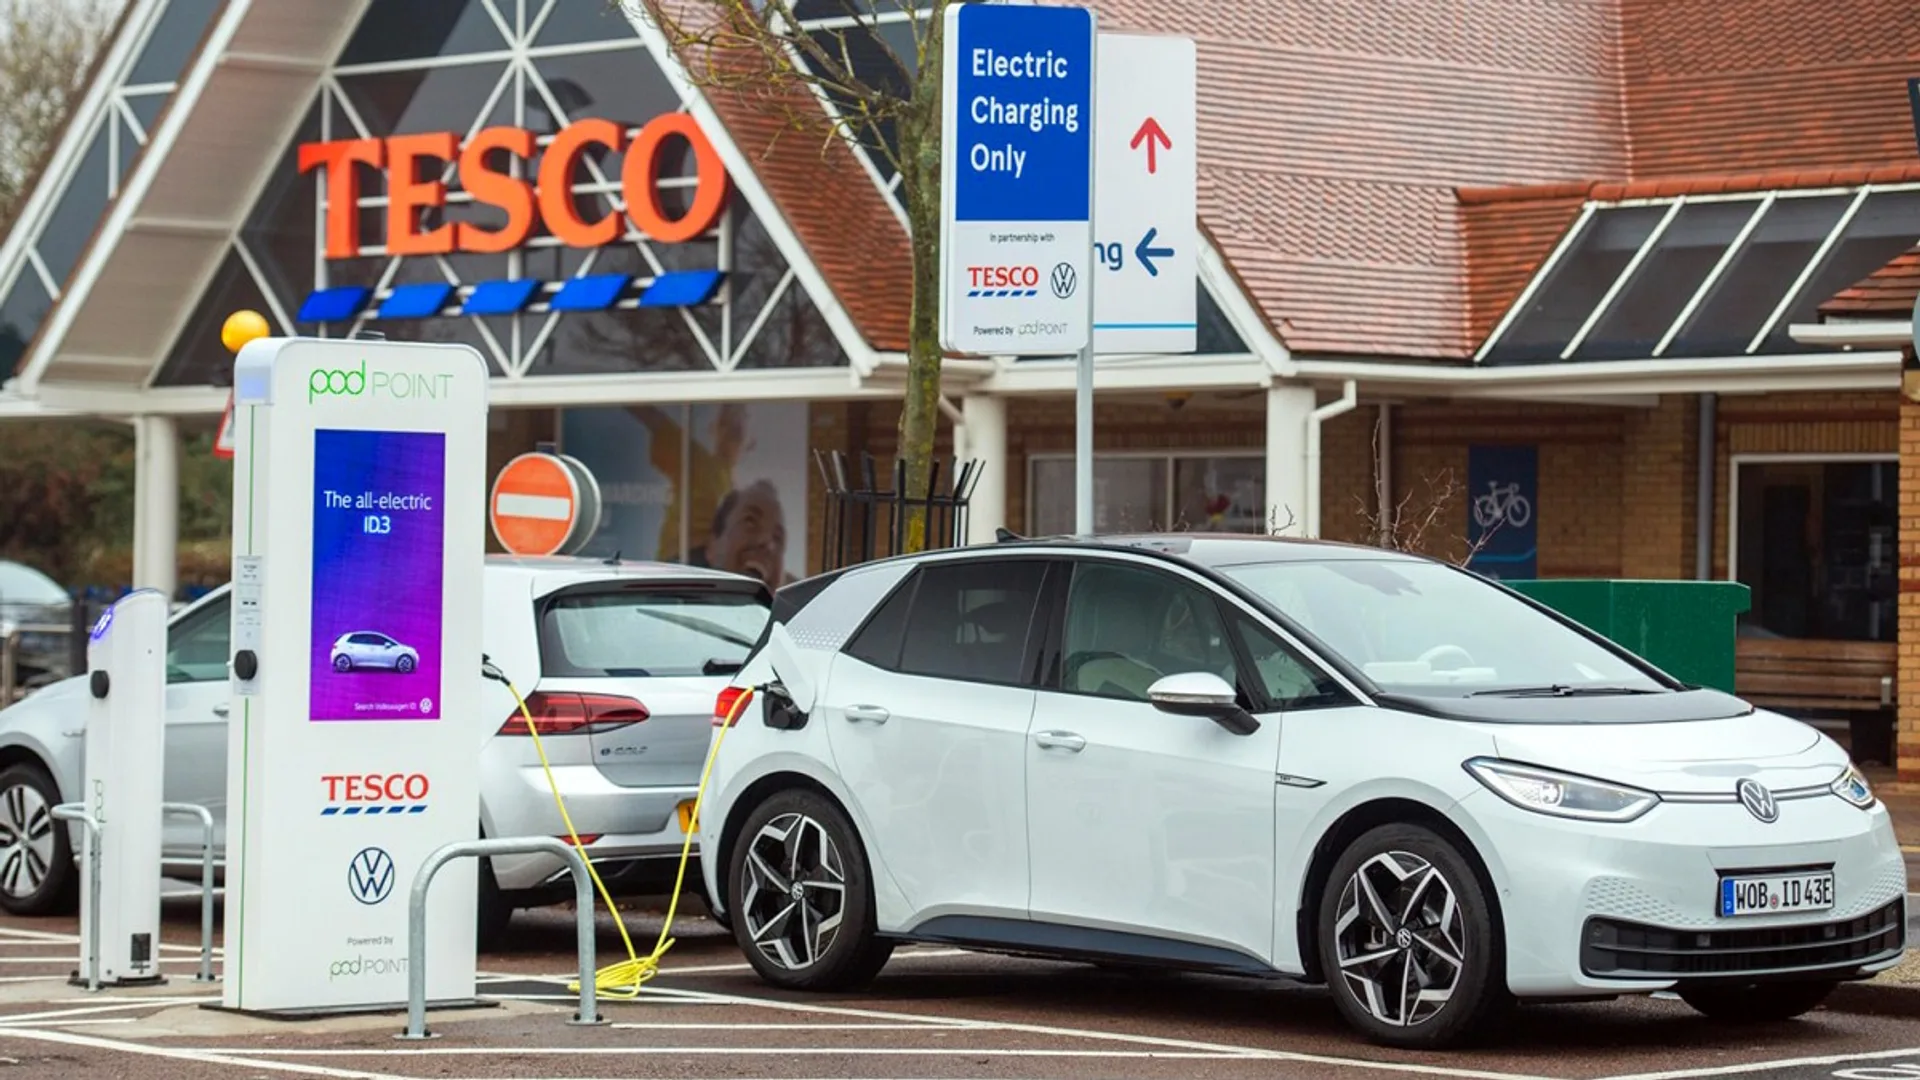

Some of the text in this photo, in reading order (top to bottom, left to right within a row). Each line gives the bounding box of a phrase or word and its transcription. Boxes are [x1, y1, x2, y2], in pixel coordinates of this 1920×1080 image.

[972, 48, 1068, 78] Electric
[970, 96, 1079, 133] Charging
[970, 143, 1027, 179] Only
[299, 112, 728, 259] TESCO
[990, 233, 1055, 244] In partnership with
[967, 266, 1039, 287] TESCO
[973, 325, 1003, 336] Powered
[1004, 325, 1014, 337] by
[1039, 323, 1068, 335] POINT
[309, 359, 454, 404] pod POINT
[323, 490, 433, 511] The all-electric
[321, 774, 429, 801] TESCO
[1736, 878, 1832, 909] WOB ID 43E
[347, 936, 393, 947] Powered by
[329, 953, 362, 982] pod
